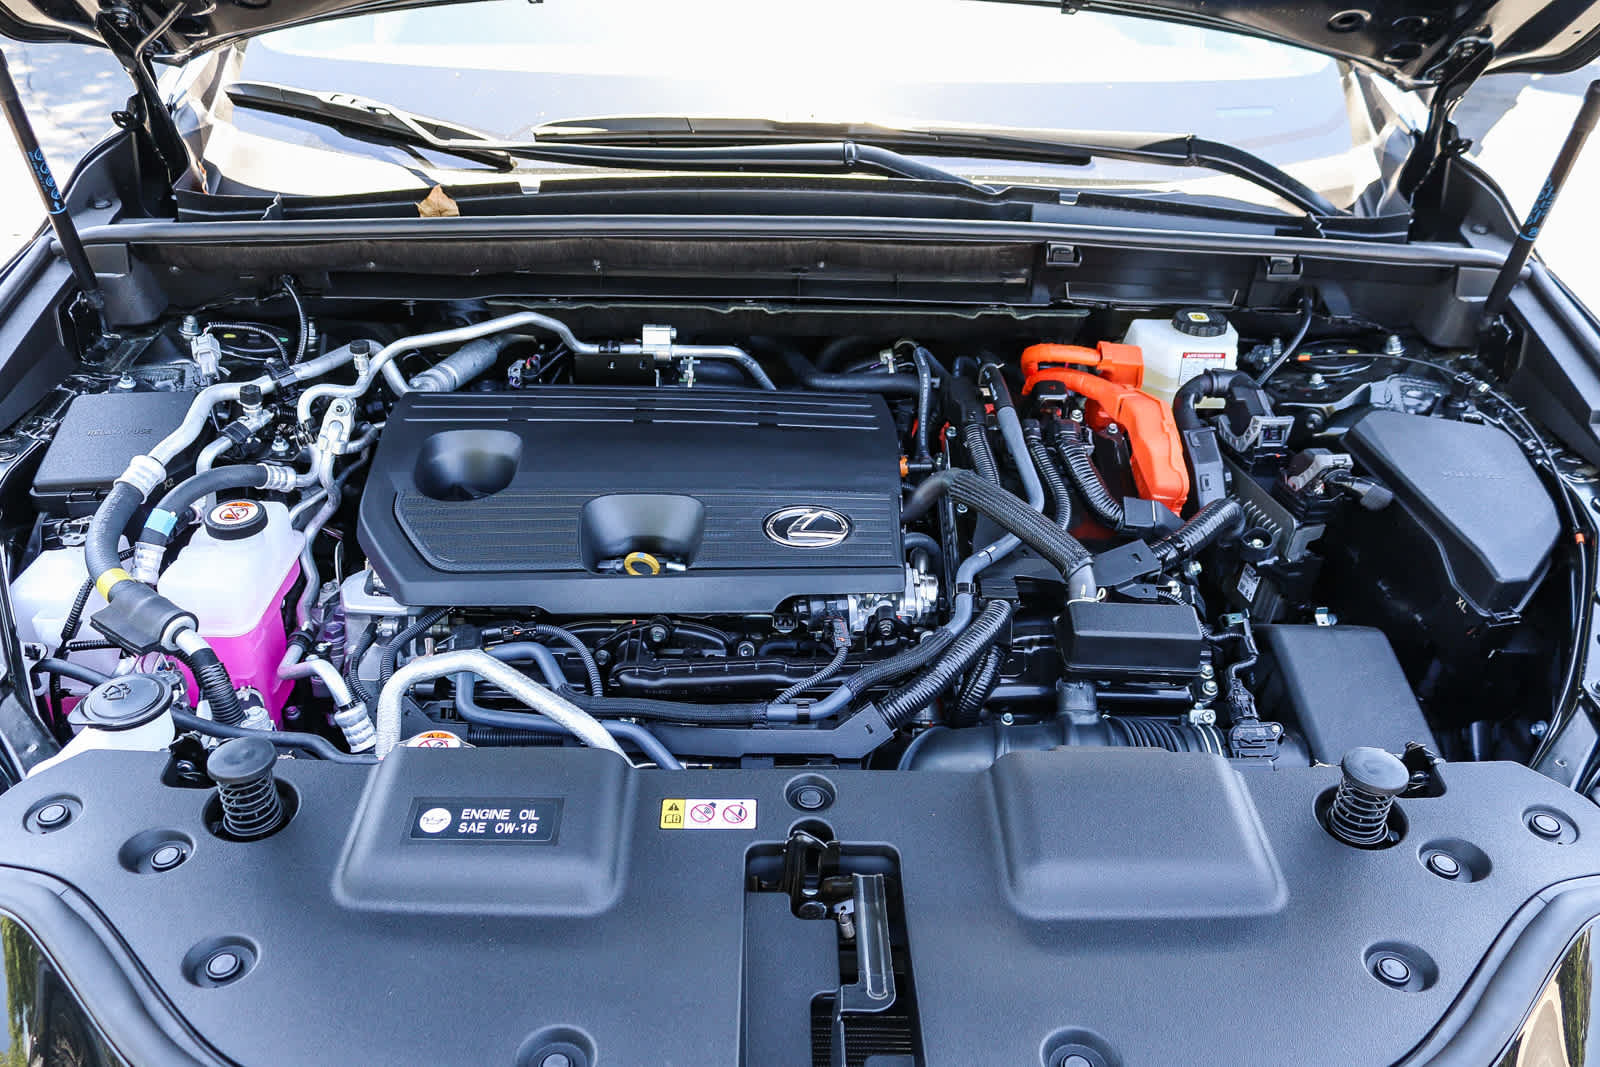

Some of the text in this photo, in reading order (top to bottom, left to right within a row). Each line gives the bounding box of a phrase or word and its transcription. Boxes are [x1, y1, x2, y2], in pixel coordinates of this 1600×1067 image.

[461, 808, 540, 820] ENGINE OIL
[458, 822, 487, 833] SAE
